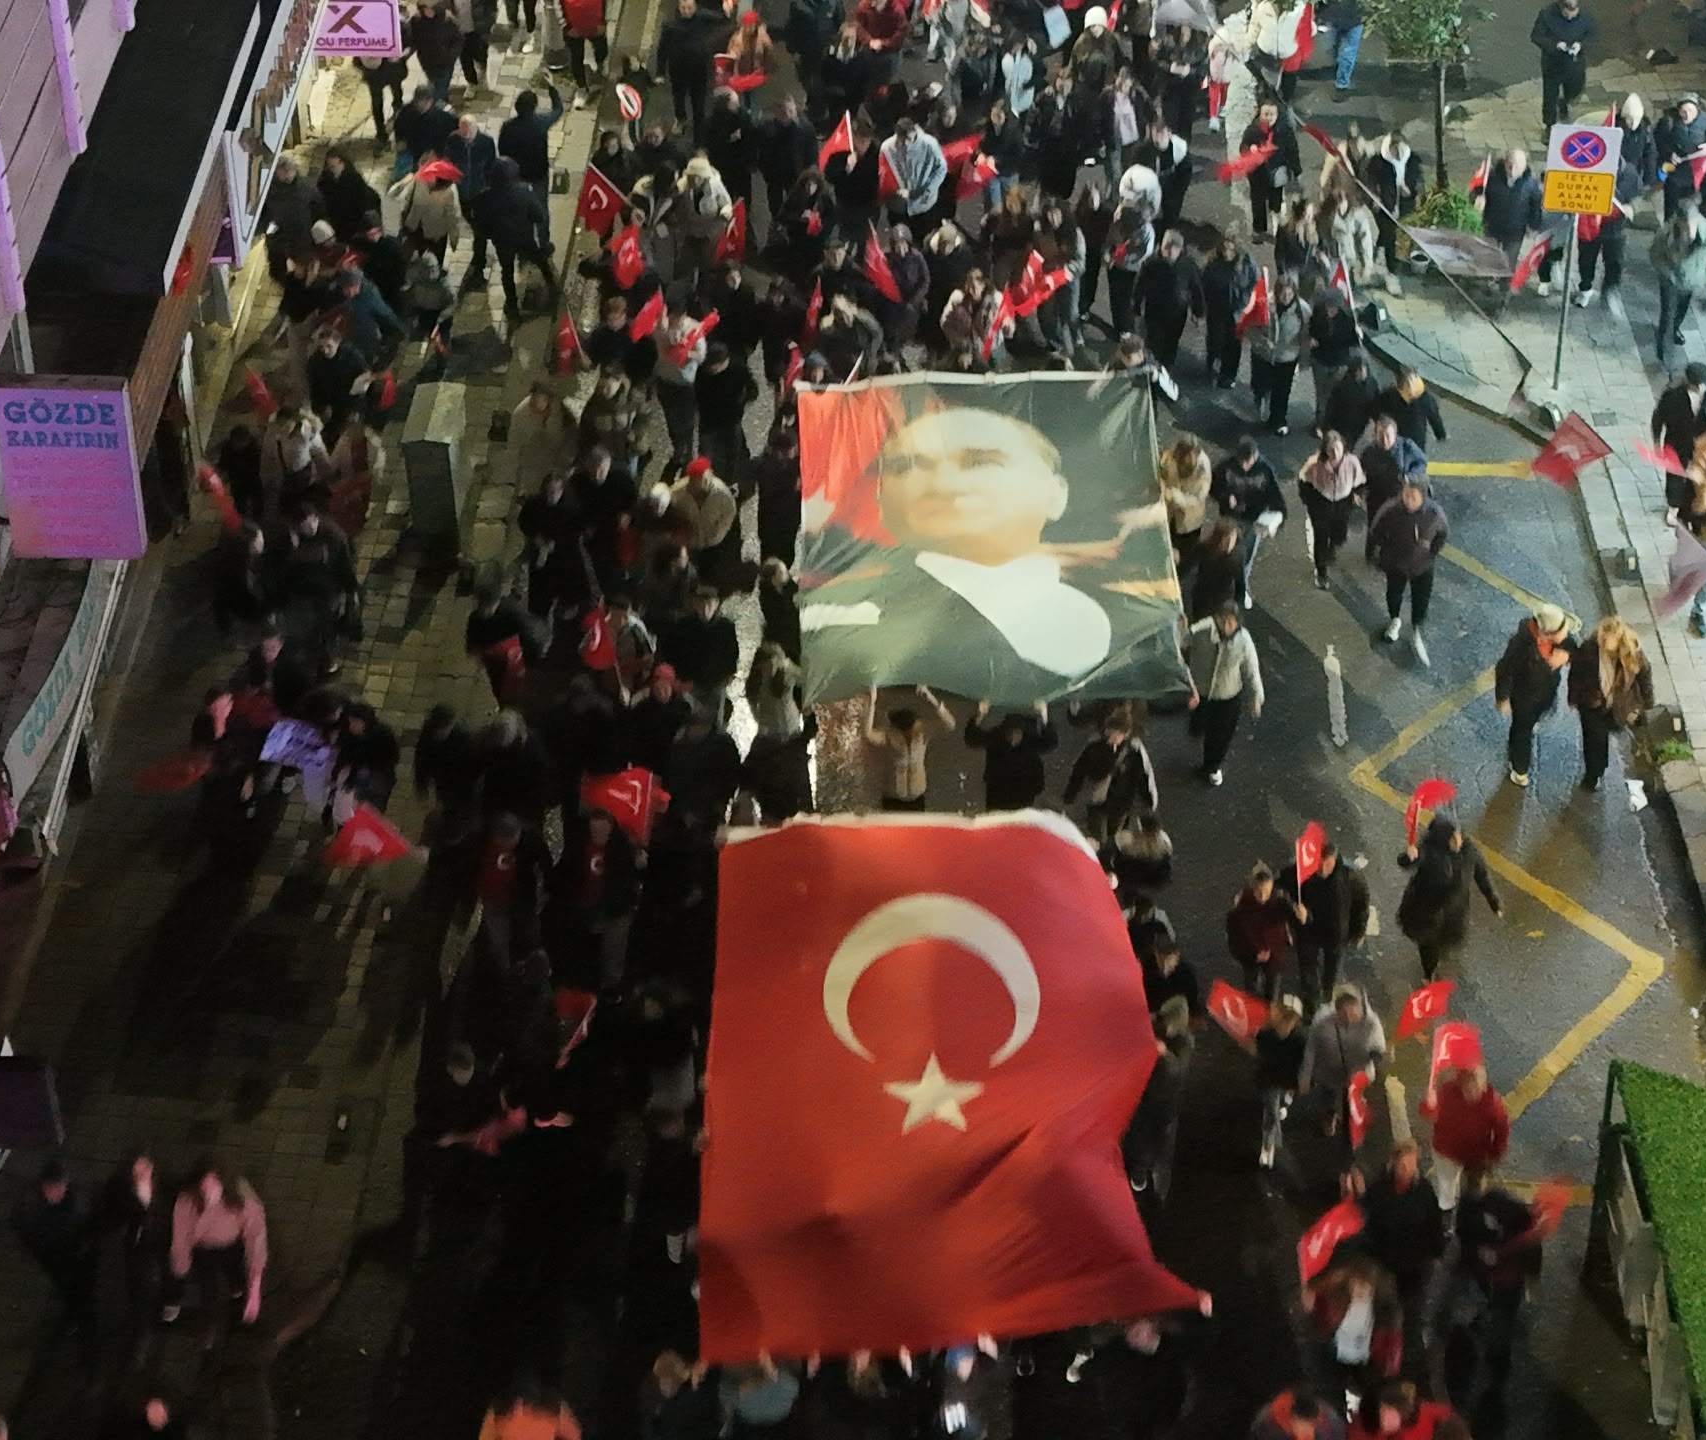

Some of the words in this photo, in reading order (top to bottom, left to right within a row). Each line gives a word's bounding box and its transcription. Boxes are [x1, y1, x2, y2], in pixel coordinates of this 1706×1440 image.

[338, 37, 388, 47] PERFUME
[1557, 183, 1599, 192] DURAK
[1558, 192, 1597, 201] ALANI
[3, 397, 117, 426] GÖZDE
